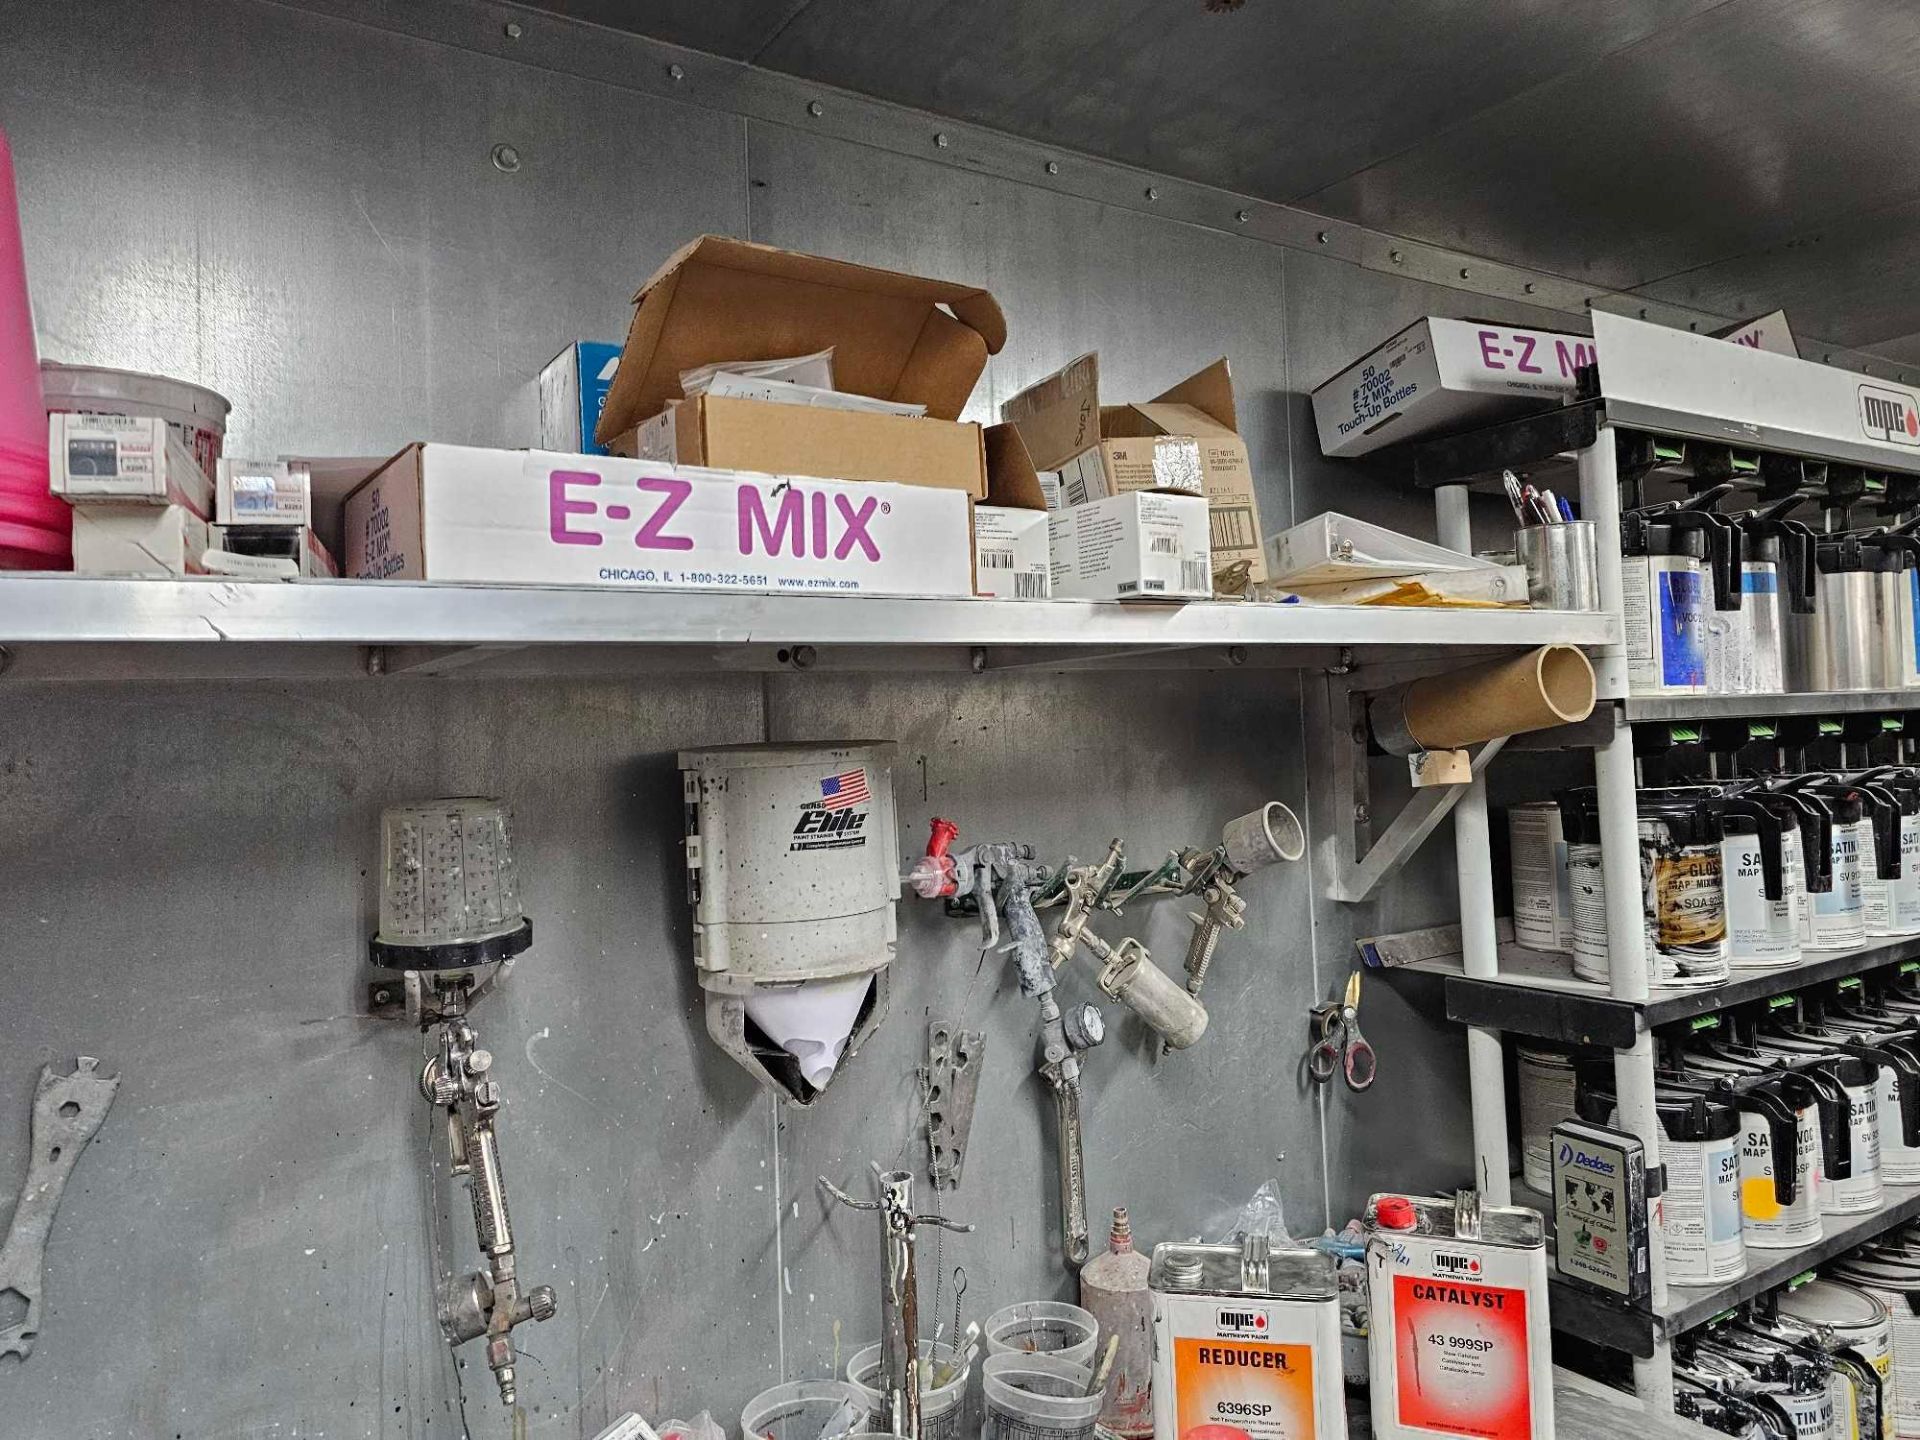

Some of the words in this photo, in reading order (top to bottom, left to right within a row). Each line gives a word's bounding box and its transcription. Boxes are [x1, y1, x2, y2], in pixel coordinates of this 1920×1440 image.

[1478, 331, 1543, 374] E-Z
[1555, 340, 1598, 378] MI
[1360, 369, 1391, 395] 70002
[1362, 365, 1375, 381] 50
[1338, 404, 1381, 435] Touch-Up
[1383, 383, 1417, 409] Bottles
[1353, 395, 1370, 414] E-Z
[1113, 451, 1127, 460] 3M
[549, 470, 694, 551] E-Z
[383, 553, 405, 578] Bottles
[599, 568, 658, 582] CHICAGO,
[663, 571, 673, 583] IL
[680, 573, 768, 586] 1-800-322-5651
[778, 577, 859, 589] www.ezmix.com
[793, 807, 869, 834] Elite
[1738, 869, 1760, 877] MAP
[1840, 872, 1850, 881] SV
[1850, 1100, 1876, 1117] SATIN
[1743, 1148, 1766, 1157] MAP
[1575, 1152, 1616, 1173] Dedoes
[1718, 1173, 1733, 1184] MAP
[1413, 1284, 1505, 1309] CATALYST
[1428, 1334, 1445, 1346] 43
[1449, 1337, 1493, 1352] 999SP
[1199, 1348, 1287, 1369] REDUCER
[1217, 1402, 1272, 1416] 6396SP
[1795, 1411, 1817, 1425] TIN
[1798, 1424, 1825, 1436] MIXING
